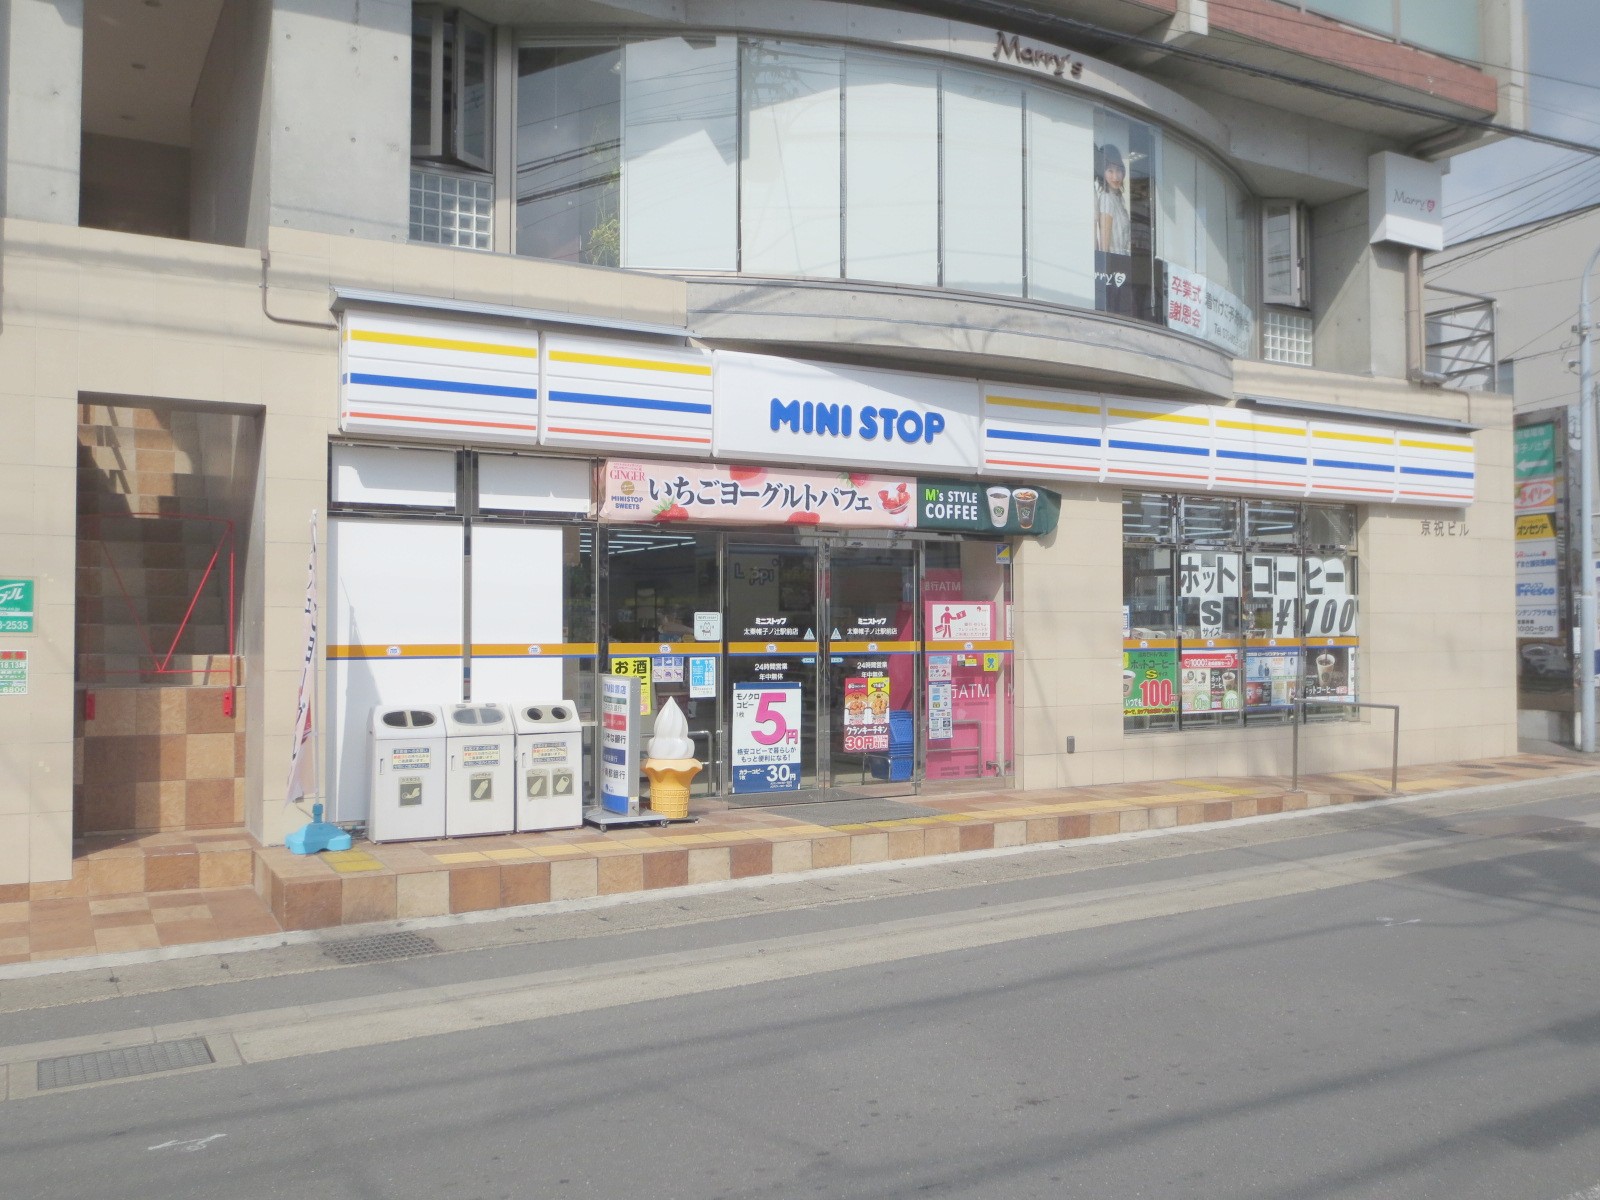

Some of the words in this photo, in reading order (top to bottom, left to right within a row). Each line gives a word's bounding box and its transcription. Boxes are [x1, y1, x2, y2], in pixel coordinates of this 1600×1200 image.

[1171, 275, 1202, 304] 卒業式
[1168, 300, 1202, 329] 謝恩会
[770, 398, 852, 437] MINI
[859, 406, 945, 443] STOP
[609, 469, 645, 481] GINGER
[611, 495, 644, 503] MINISTOP
[649, 476, 872, 512] いちごヨーグルトパフェ
[925, 489, 944, 502] M's
[947, 491, 978, 504] STYLE
[615, 502, 640, 510] SWEETS
[925, 503, 978, 521] COFFEE
[1420, 520, 1470, 537] 京祝ビル
[1180, 556, 1237, 594] ホット
[1253, 557, 1345, 596] コーヒー
[1516, 584, 1555, 596] Fresco
[1201, 600, 1222, 626] S
[755, 617, 787, 625] ミニストップ
[858, 617, 887, 625] ミニストップ
[743, 627, 799, 636] 太秦帷子ノ辻駅前店
[1202, 627, 1222, 638] サイズ
[615, 660, 647, 674] お酒
[755, 662, 788, 671] 24時間営業
[857, 661, 888, 670] 24時間営業
[759, 673, 784, 681] 年中無休
[846, 726, 888, 736] クランキーチキン
[737, 747, 796, 756] 格安コピーで暮らしが
[741, 754, 791, 763] もっと便利になる!
[766, 764, 796, 782] 30円
